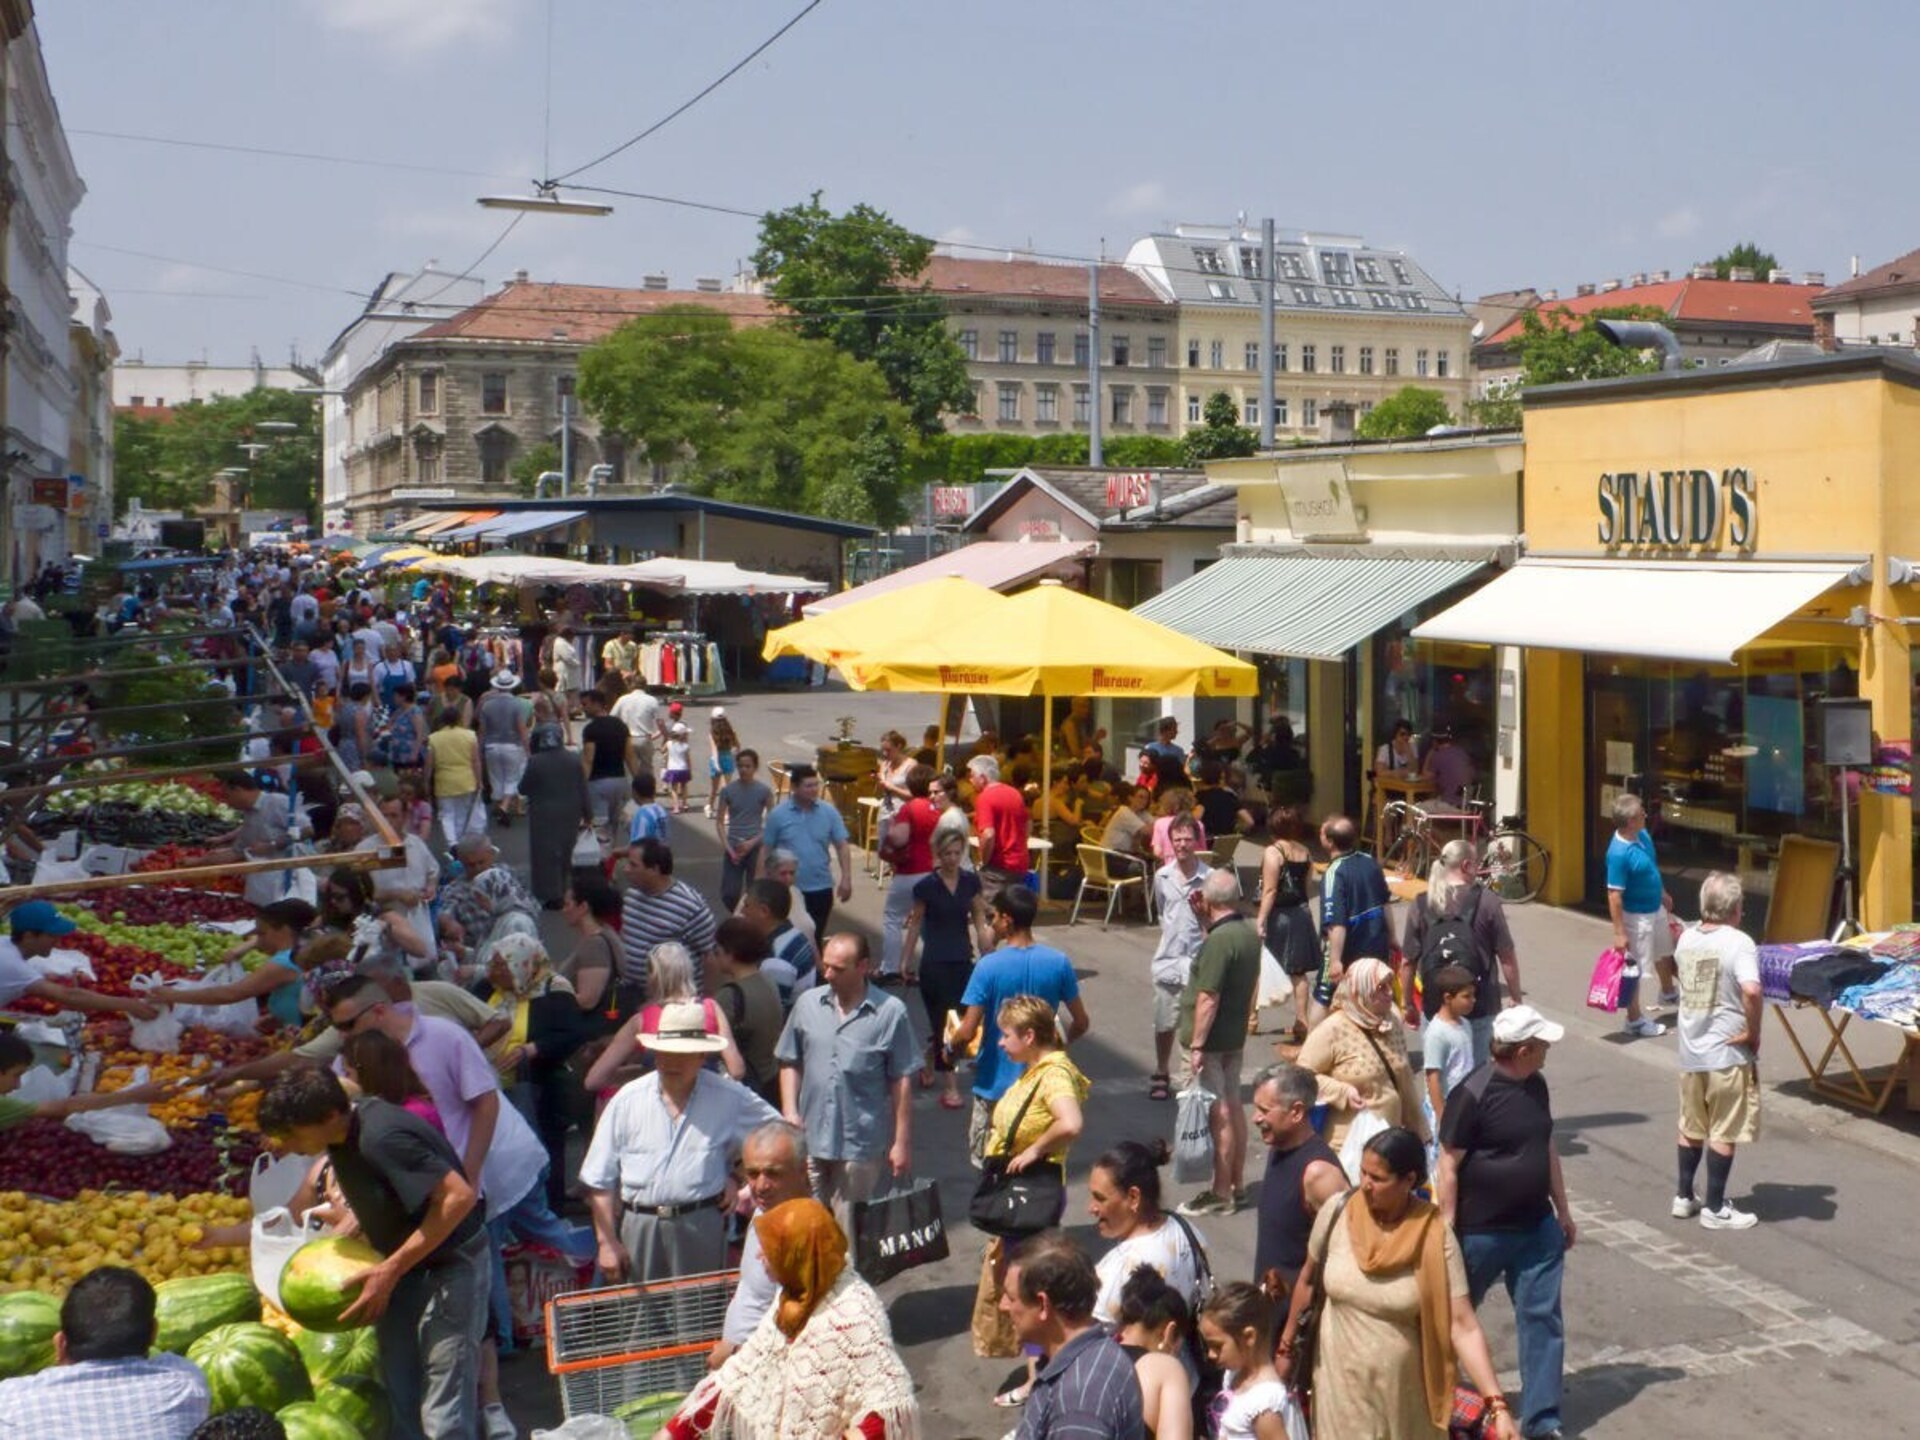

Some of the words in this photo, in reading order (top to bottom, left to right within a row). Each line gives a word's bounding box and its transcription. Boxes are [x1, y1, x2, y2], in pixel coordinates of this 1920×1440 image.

[1106, 472, 1151, 508] WURST
[1598, 467, 1756, 552] STAUD'S
[1092, 667, 1143, 692] Murauer
